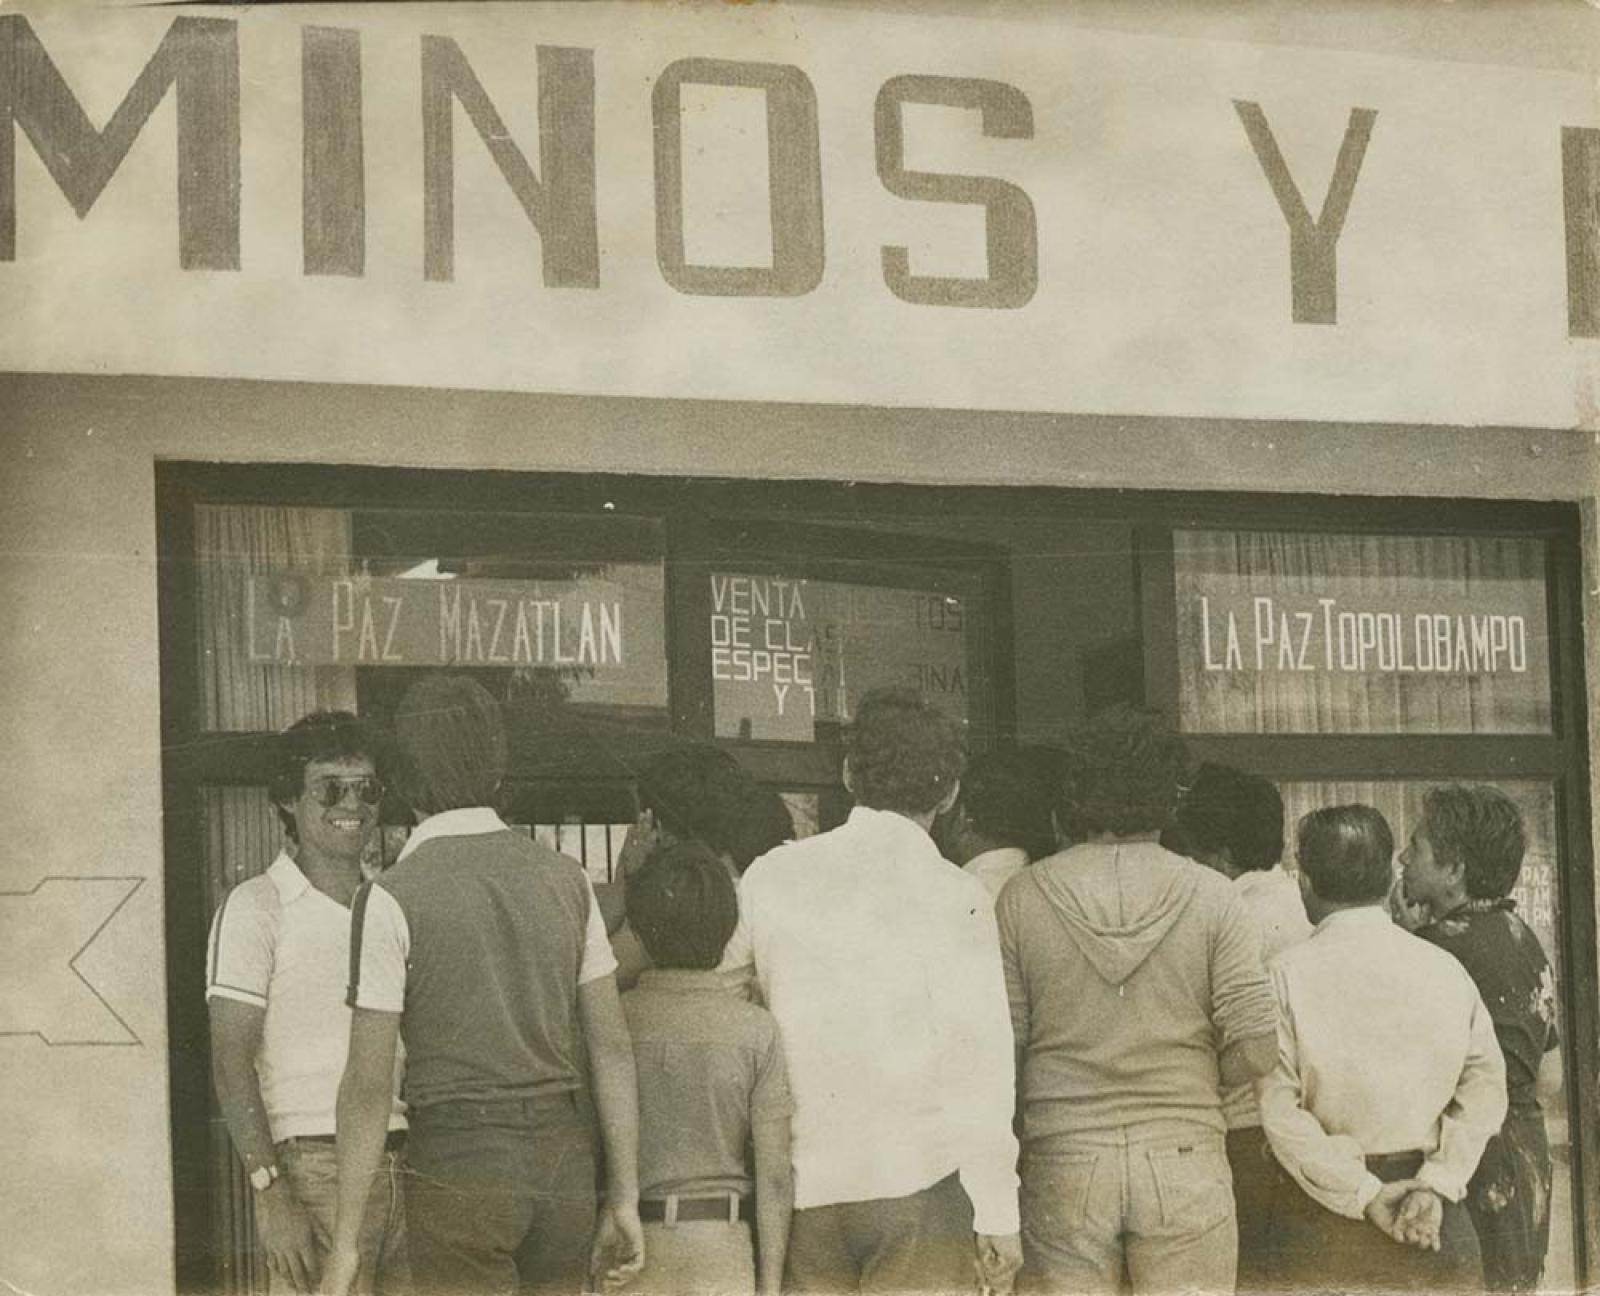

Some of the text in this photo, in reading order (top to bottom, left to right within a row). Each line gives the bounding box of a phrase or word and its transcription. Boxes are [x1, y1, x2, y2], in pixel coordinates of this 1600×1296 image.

[1233, 99, 1379, 325] Y
[710, 575, 806, 619] VENTA
[247, 578, 623, 665] LA PAZ MAZATLAN
[711, 615, 751, 648] DE
[1201, 596, 1527, 672] LA PAZ TOPOLOBAMPO
[773, 683, 789, 716] Y
[1521, 865, 1550, 886] PAZ
